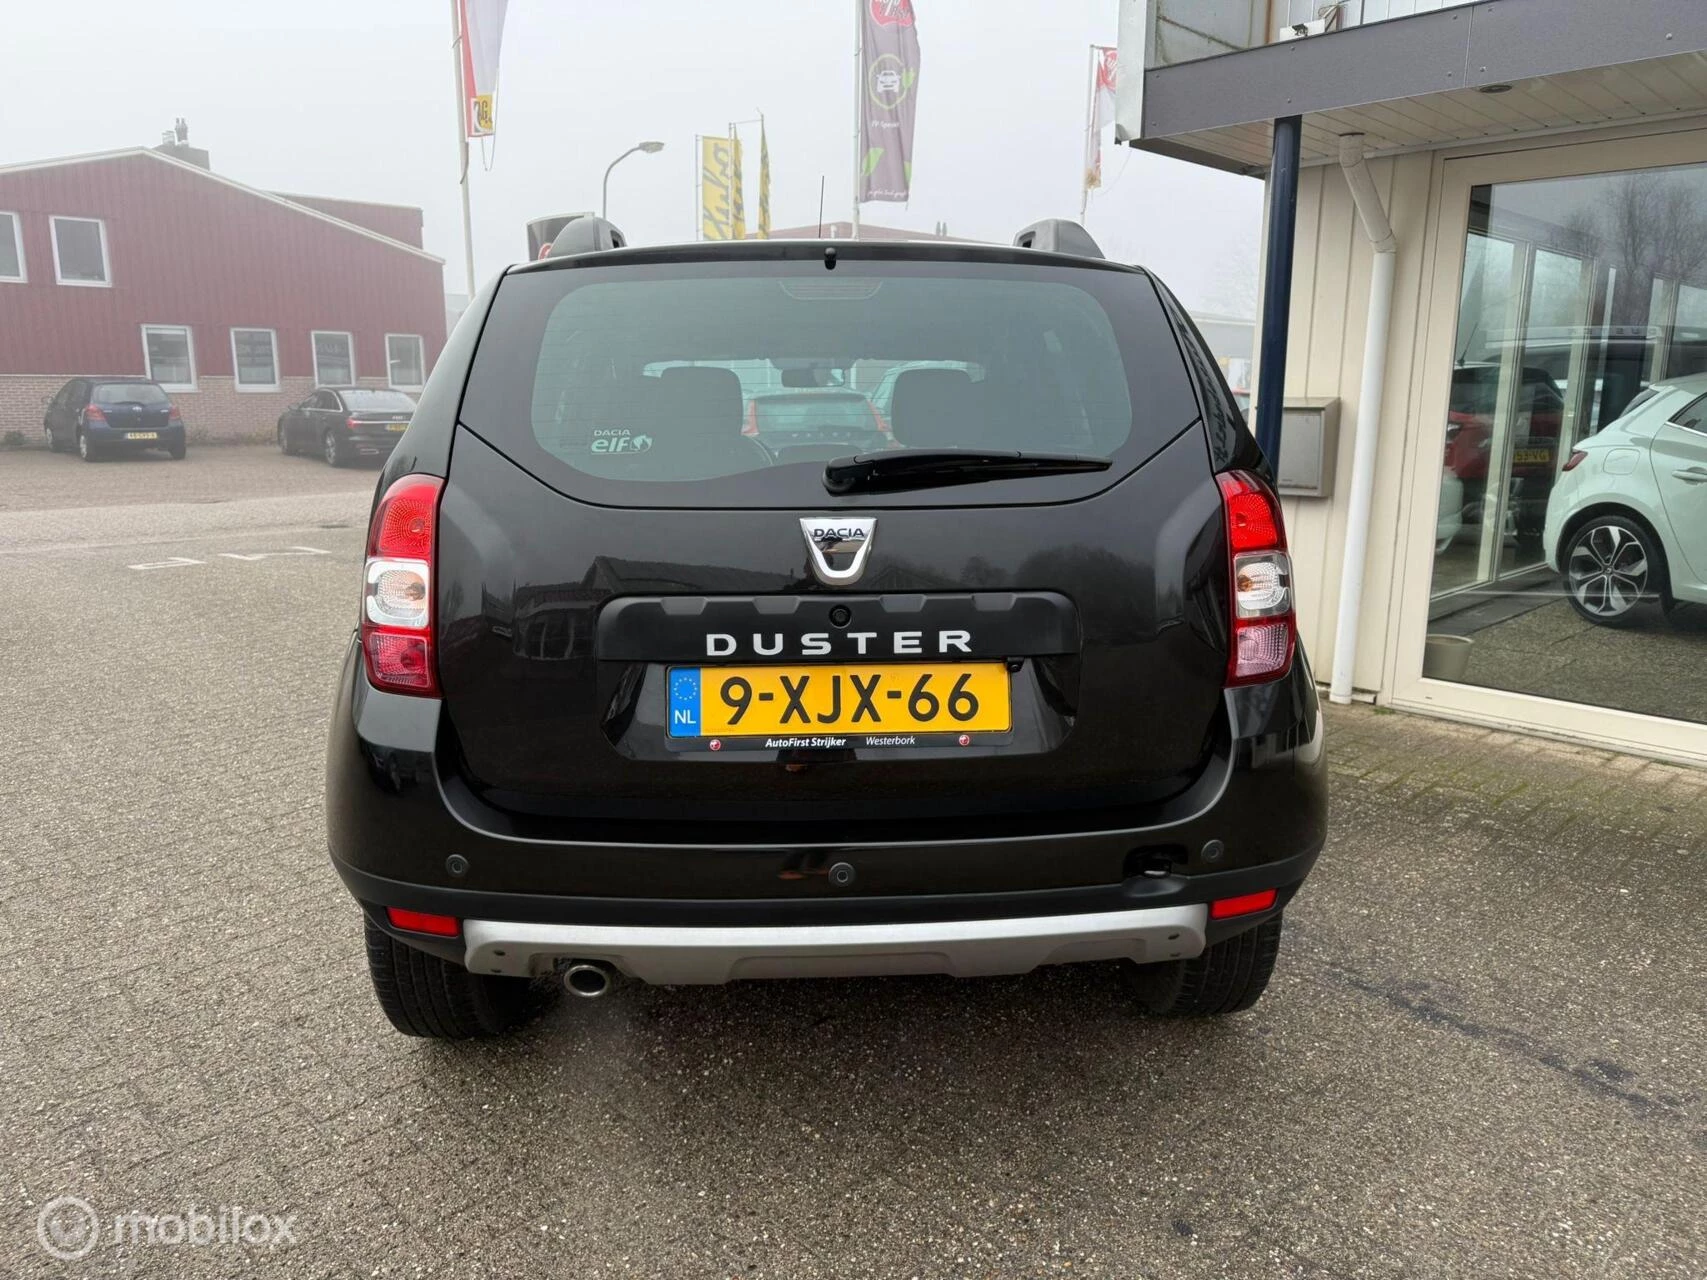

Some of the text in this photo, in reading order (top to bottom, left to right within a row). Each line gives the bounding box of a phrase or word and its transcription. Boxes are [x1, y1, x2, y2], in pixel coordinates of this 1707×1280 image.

[593, 429, 632, 437] DACIA
[813, 528, 865, 538] DACIA
[706, 630, 972, 656] DUSTER
[720, 673, 979, 726] 9-XJX-66
[674, 709, 697, 725] NL
[765, 735, 916, 749] AutoFirst Strijker Westerbork
